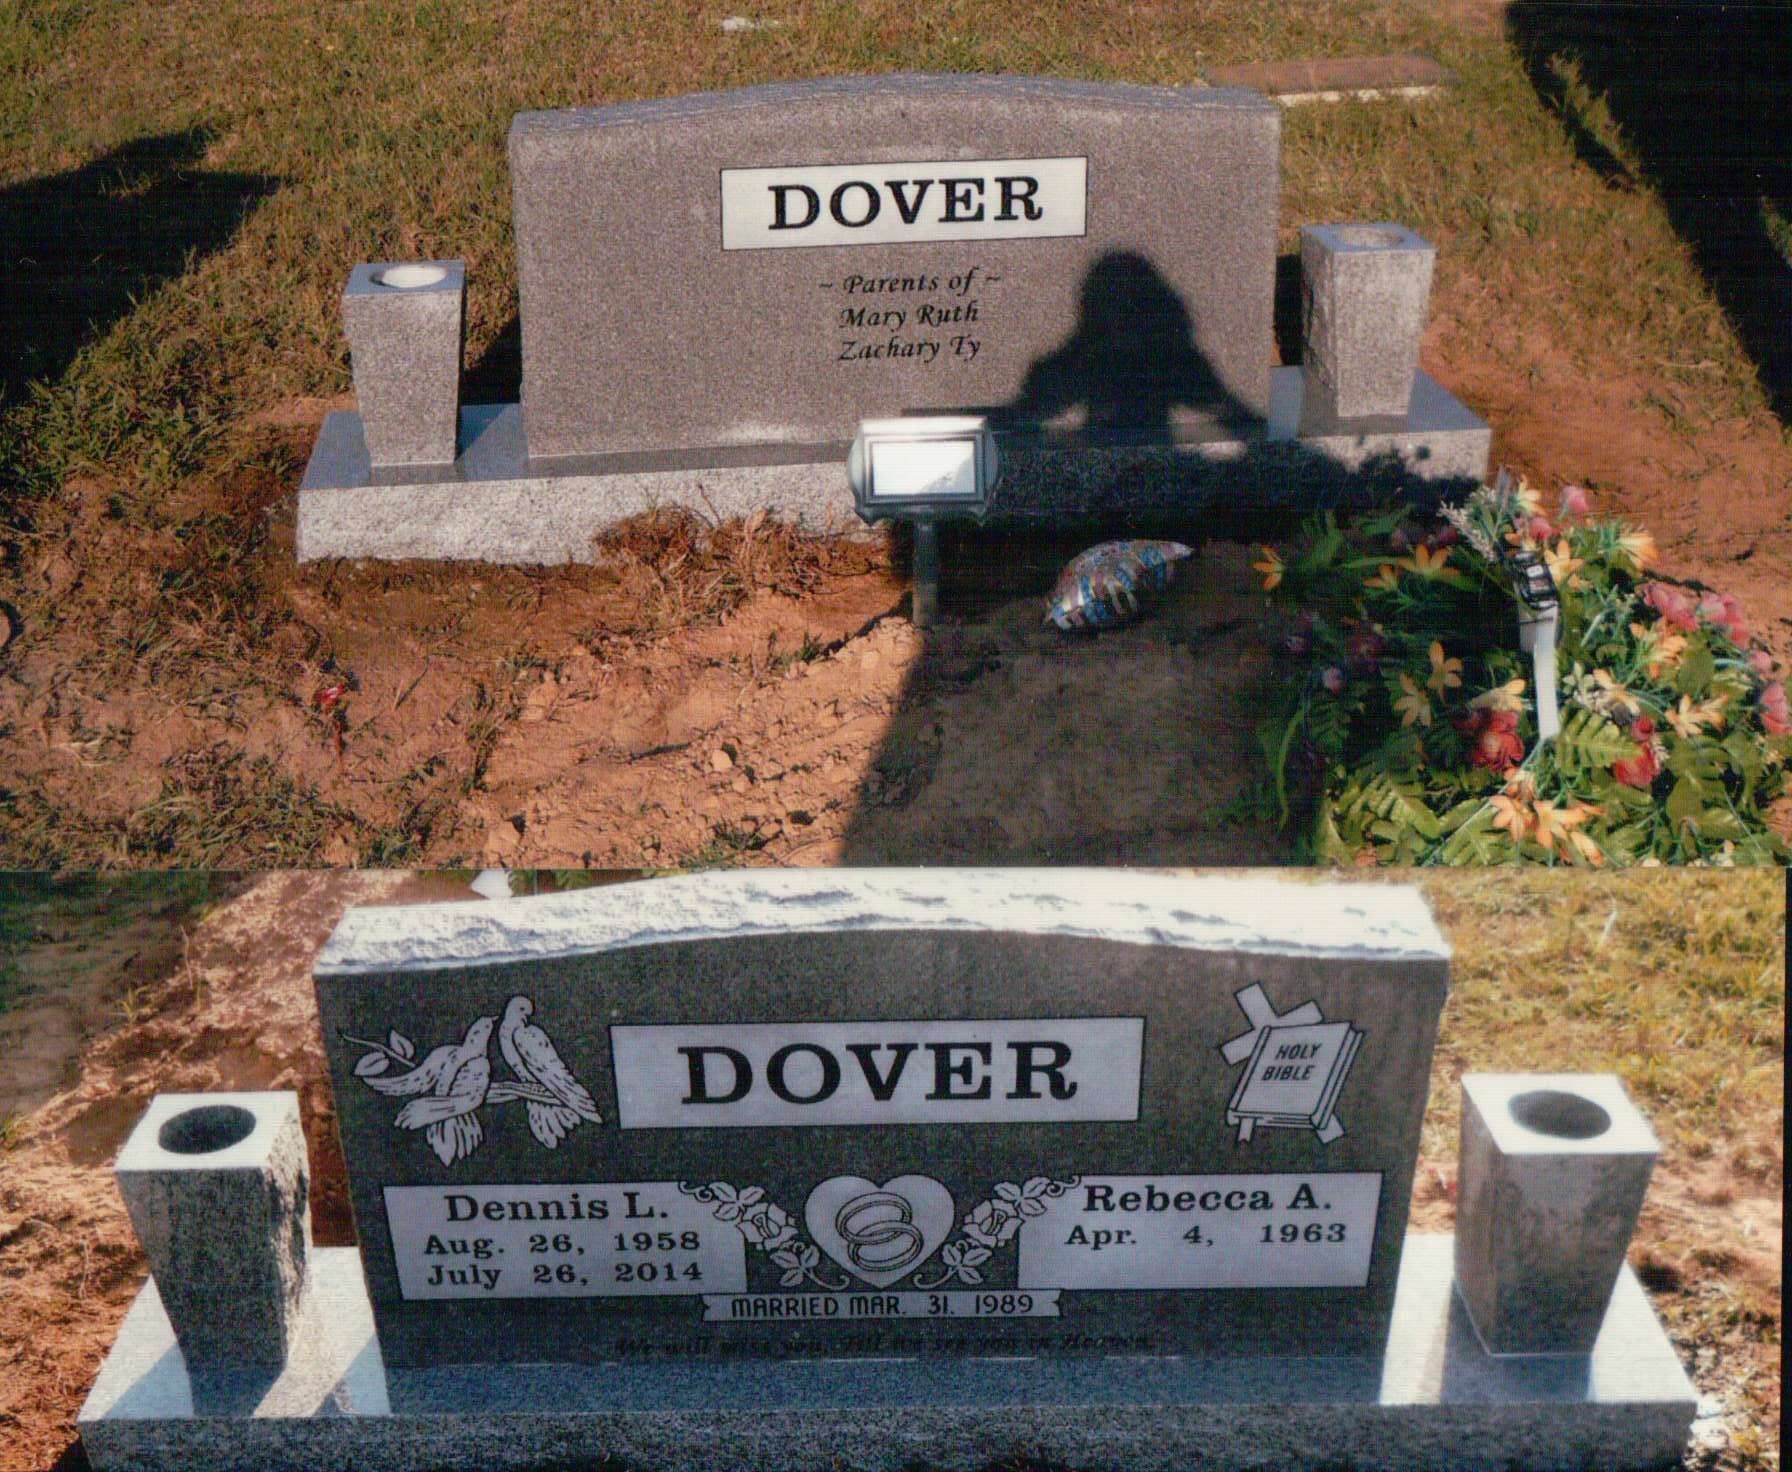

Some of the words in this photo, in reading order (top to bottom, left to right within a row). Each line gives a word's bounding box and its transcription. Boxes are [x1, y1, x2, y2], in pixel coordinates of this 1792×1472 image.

[768, 176, 1043, 230] DOVER
[842, 273, 939, 295] Parents
[948, 266, 980, 296] of
[838, 306, 907, 332] Mary
[916, 301, 980, 326] Ruth
[838, 338, 941, 363] Zachary
[950, 335, 982, 361] Ty
[1275, 1043, 1322, 1060] HOLY
[677, 1041, 1079, 1105] DOVER
[1261, 1065, 1316, 1081] BIBLE
[443, 1192, 610, 1222] Dennis
[622, 1191, 669, 1219] L.
[1082, 1184, 1273, 1212] Rebecca
[1286, 1183, 1332, 1211] A.
[423, 1233, 504, 1259] Aug.
[529, 1233, 585, 1256] 26,
[613, 1231, 700, 1252] 1958
[1063, 1225, 1138, 1250] Apr.
[1182, 1226, 1214, 1247] 4,
[1259, 1223, 1347, 1244] 1963
[426, 1264, 502, 1290] July
[533, 1264, 588, 1286] 26,
[614, 1261, 703, 1282] 2014
[731, 1296, 840, 1318] MARRIED
[848, 1295, 907, 1316] MAR.
[975, 1294, 1034, 1314] 1989
